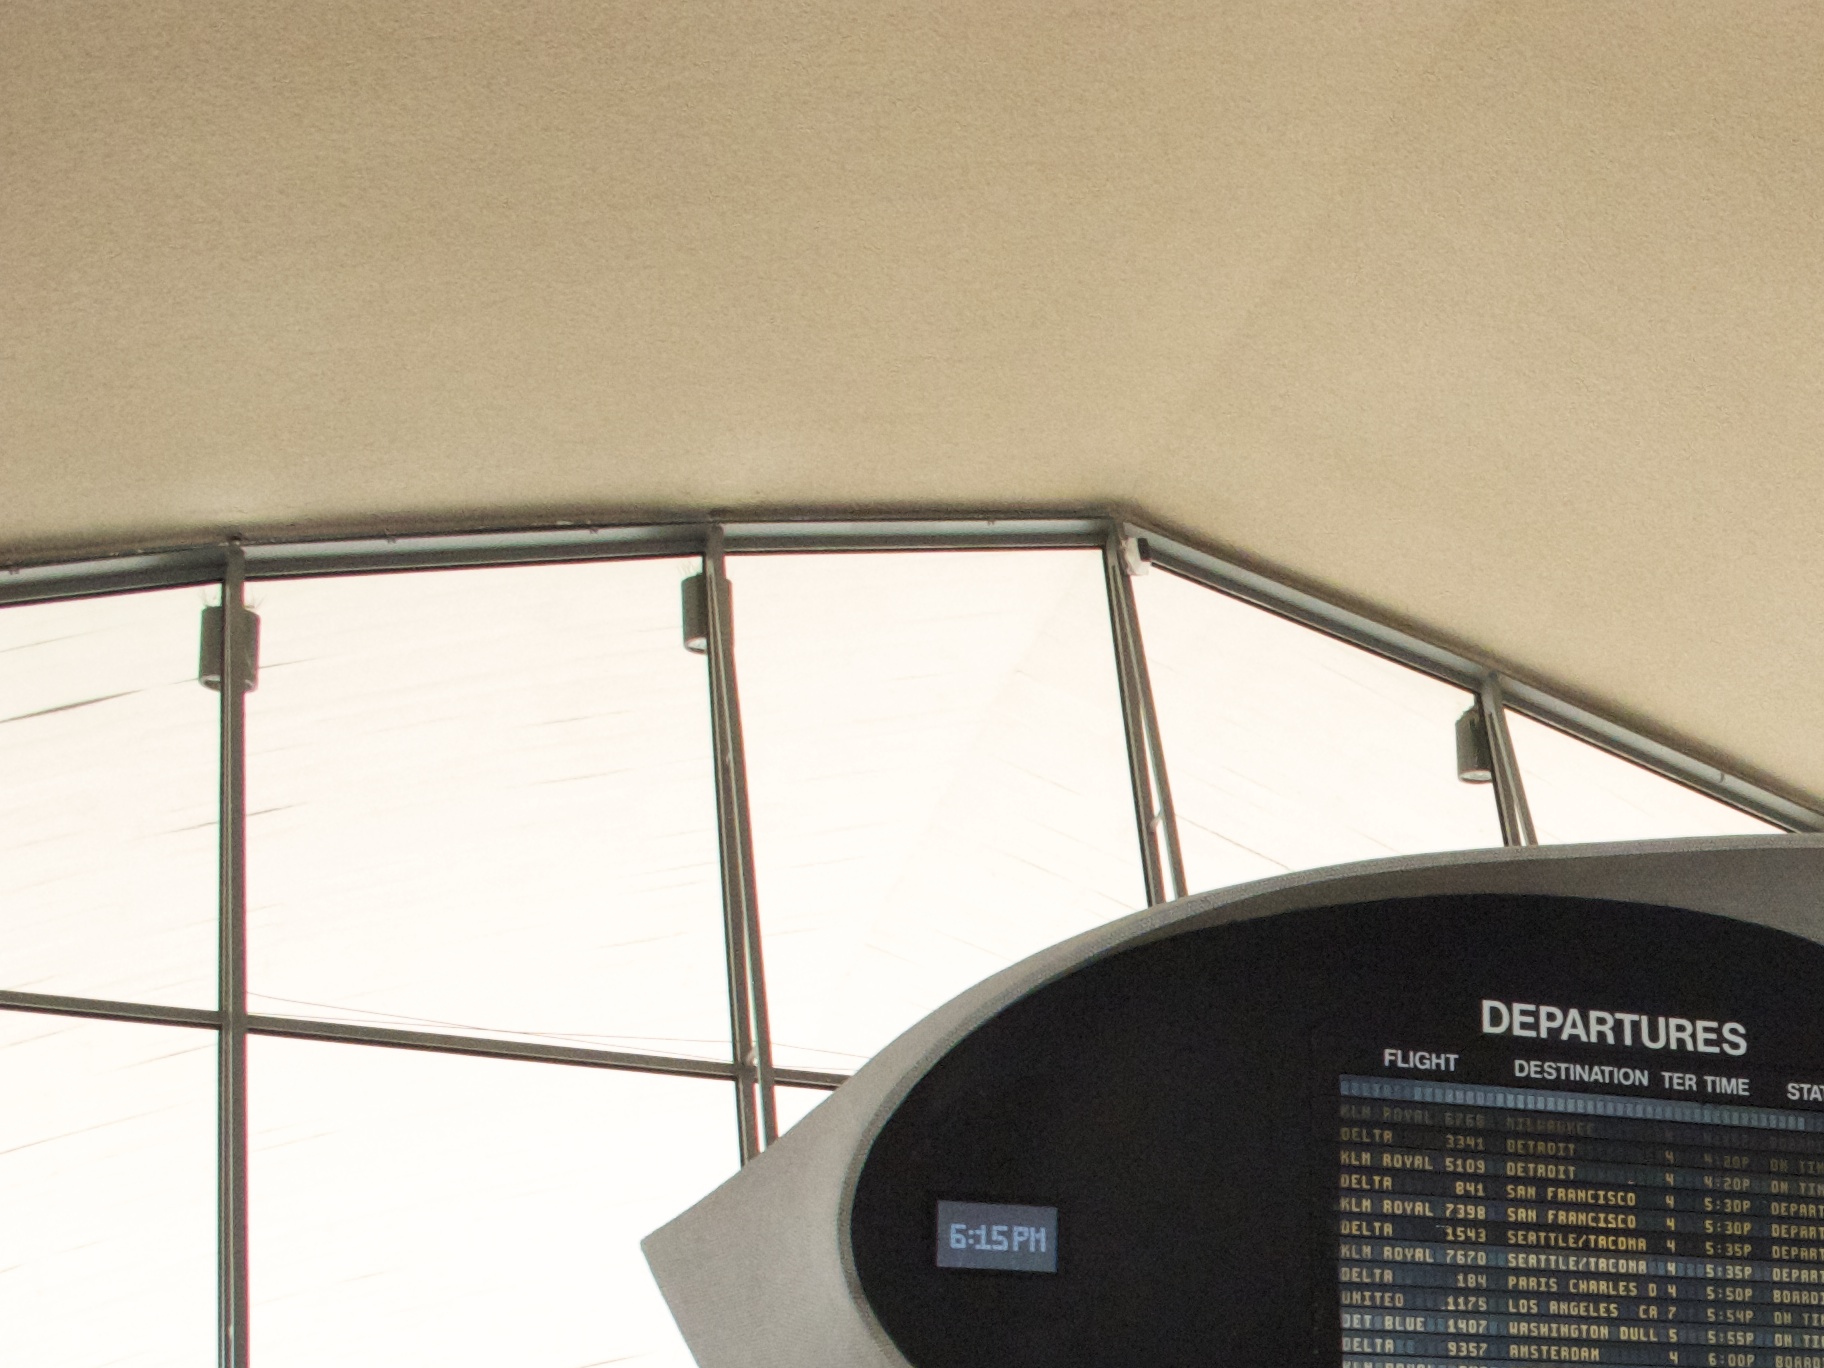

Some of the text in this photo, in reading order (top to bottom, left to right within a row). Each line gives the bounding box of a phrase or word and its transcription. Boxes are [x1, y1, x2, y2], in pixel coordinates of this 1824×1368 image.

[1481, 999, 1748, 1056] DEPARTURES
[1384, 1048, 1458, 1072] FLIGHT
[1514, 1059, 1649, 1087] DESTINATION
[1661, 1071, 1697, 1091] TER
[1704, 1075, 1750, 1096] TIME
[1340, 1149, 1372, 1166] KLM
[1383, 1153, 1435, 1171] ROYAL
[1445, 1157, 1486, 1174] 5109
[1507, 1162, 1577, 1181] DETROIT
[1771, 1179, 1789, 1194] ON
[1340, 1172, 1393, 1191] DELTA
[1456, 1181, 1487, 1197] 841
[1507, 1184, 1537, 1200] SAN
[1548, 1187, 1637, 1207] FRANCISCO
[1341, 1196, 1372, 1212] KLM
[1383, 1199, 1435, 1216] ROYAL
[1446, 1203, 1487, 1220] 7398
[1508, 1207, 1538, 1223] SAN
[1548, 1209, 1637, 1229] FRANCISCO
[1341, 1219, 1394, 1237] DELTA
[1446, 1226, 1487, 1242] 1543
[1508, 1229, 1647, 1252] SEATTLE/TACOMA
[1341, 1242, 1373, 1259] KLM
[1384, 1245, 1436, 1262] ROYAL
[1447, 1248, 1488, 1265] 7670
[1508, 1252, 1648, 1274] SEATTLE/TACOMA
[1341, 1265, 1394, 1283] DELTA
[1509, 1275, 1559, 1292] PARIS
[1569, 1278, 1639, 1296] CHARLES
[1341, 1289, 1405, 1307] UNITED
[1447, 1294, 1488, 1311] 1175
[1509, 1298, 1539, 1313] LOS
[1550, 1300, 1619, 1317] ANGELES
[1639, 1304, 1659, 1319] CA
[1774, 1310, 1792, 1325] ON
[1342, 1312, 1373, 1328] JET
[1384, 1314, 1426, 1331] BLUE
[1447, 1317, 1489, 1334] 1407
[1509, 1320, 1610, 1339] WASHINGTON
[1620, 1325, 1659, 1341] DULL
[1774, 1332, 1793, 1347] ON
[1342, 1336, 1395, 1353] DELTA
[1448, 1340, 1489, 1357] 9357
[1510, 1343, 1600, 1361] AMSTERDAM
